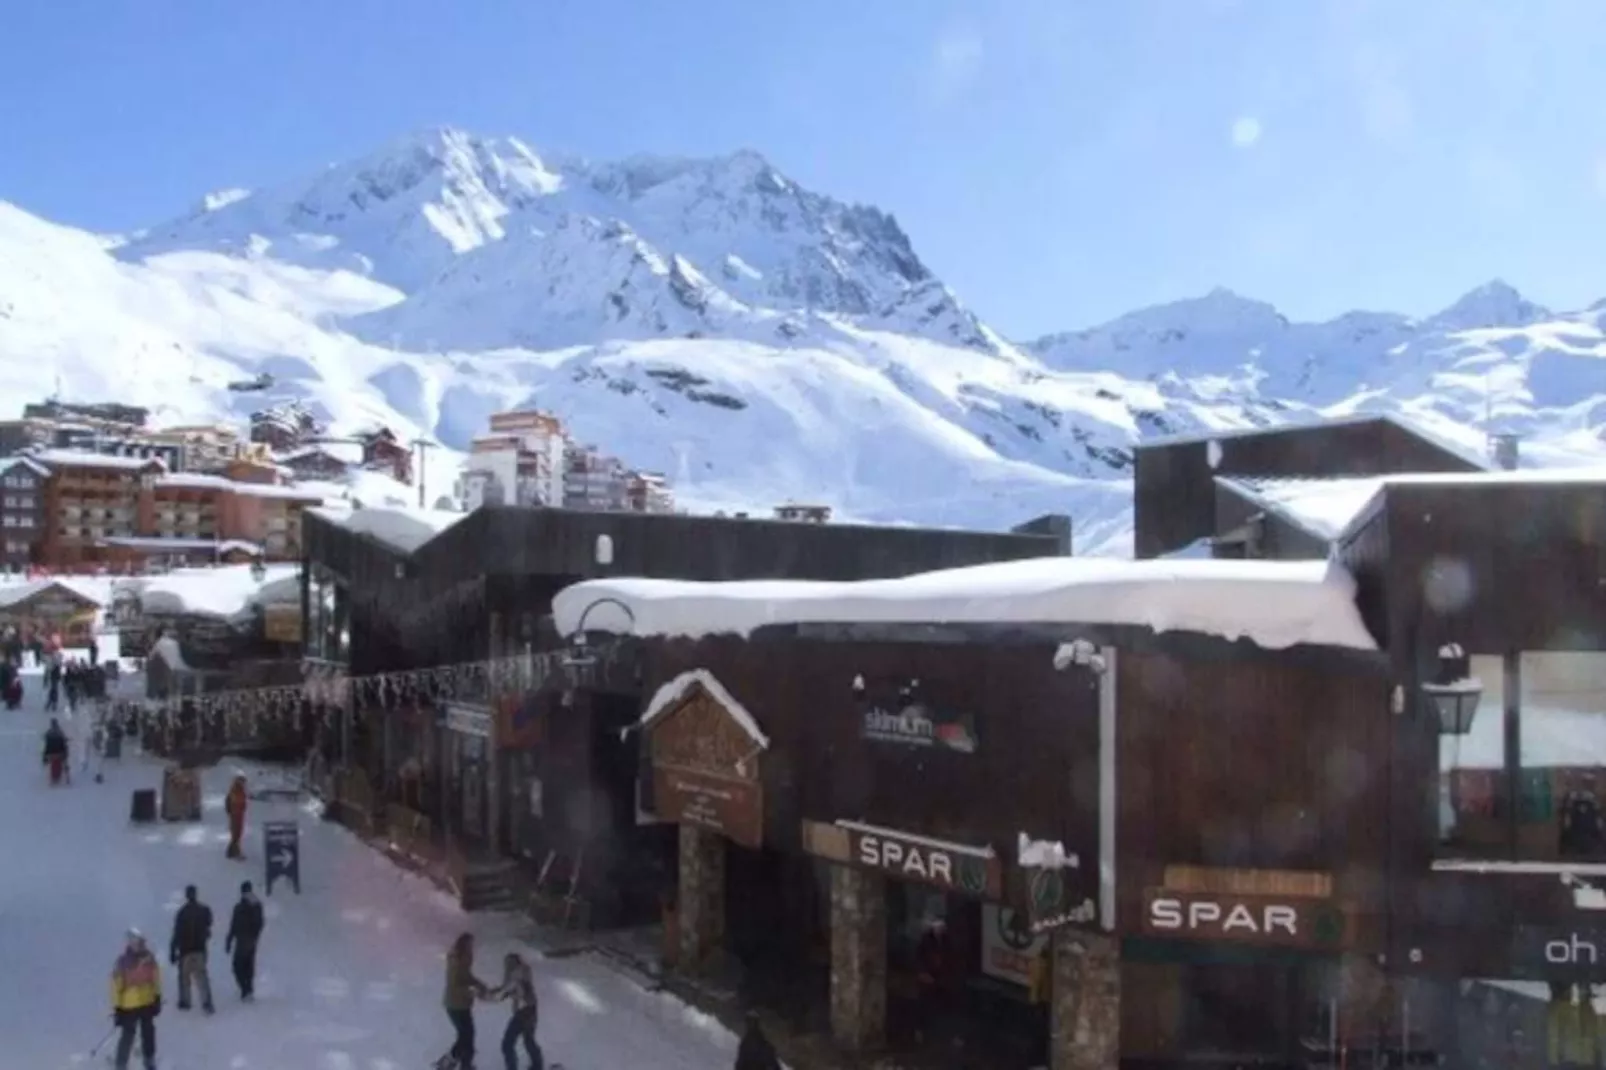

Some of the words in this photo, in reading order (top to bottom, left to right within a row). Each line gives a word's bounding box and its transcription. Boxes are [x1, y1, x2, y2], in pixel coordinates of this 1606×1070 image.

[859, 836, 952, 883] SPAR
[1151, 899, 1297, 935] SPAR
[1545, 931, 1597, 964] oh
